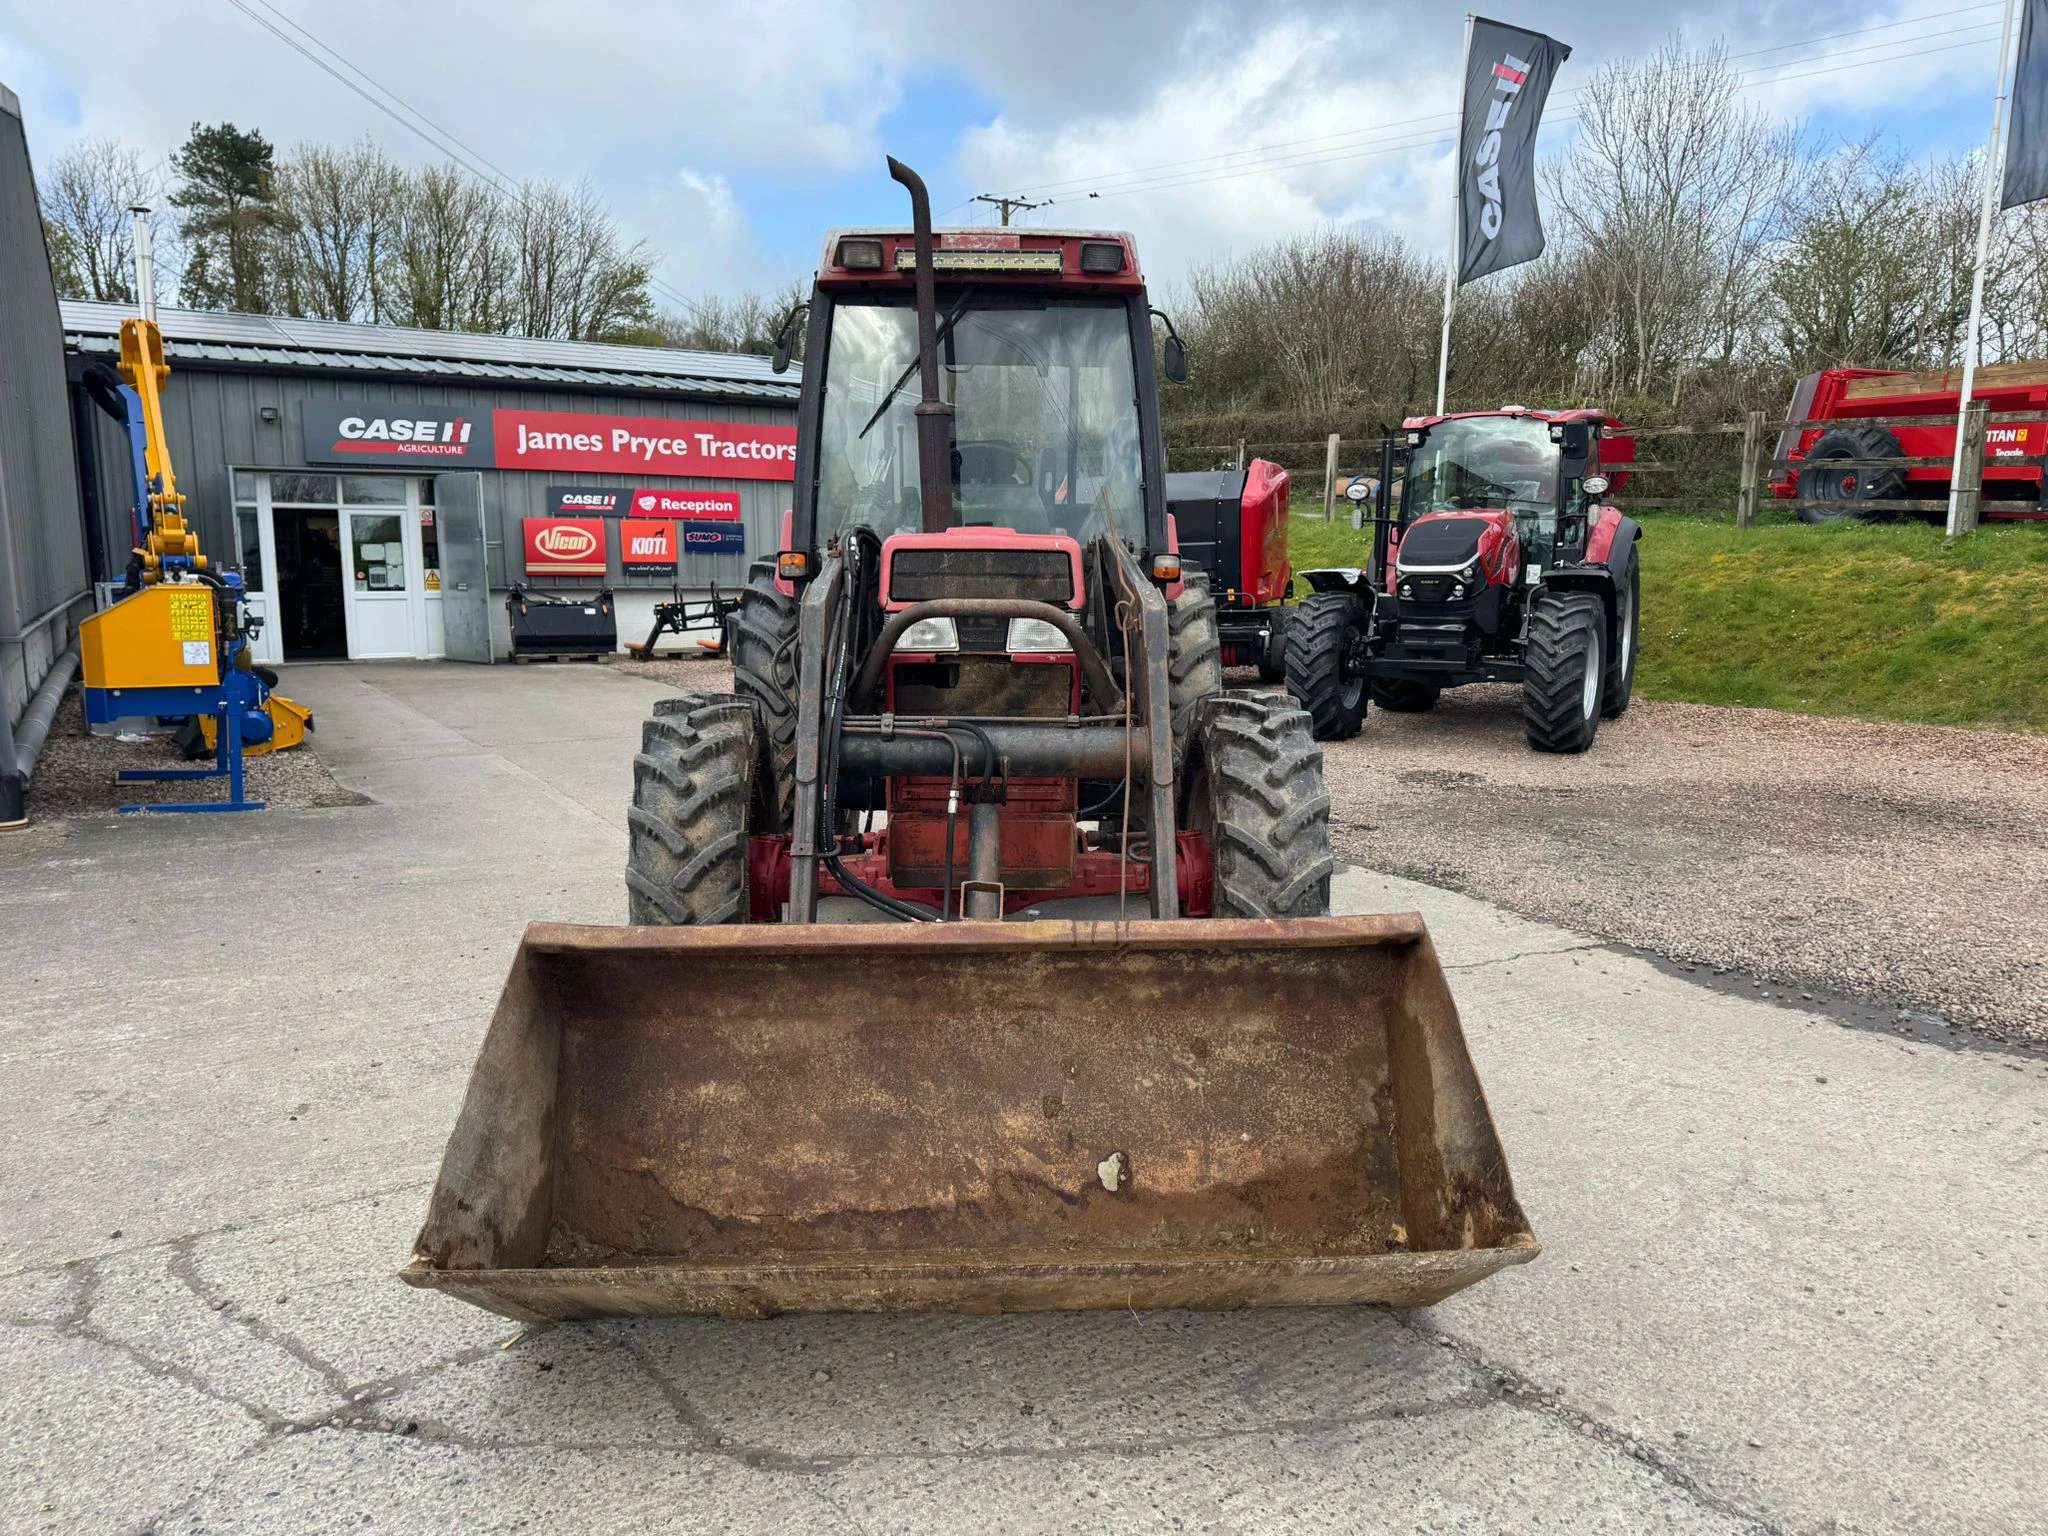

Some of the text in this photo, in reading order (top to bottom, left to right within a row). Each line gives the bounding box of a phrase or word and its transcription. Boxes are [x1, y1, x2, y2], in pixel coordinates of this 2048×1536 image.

[1475, 99, 1513, 240] CASE
[338, 417, 438, 441] CASE
[1986, 429, 2016, 442] ITAN
[397, 444, 463, 454] AGRICULTURE
[516, 424, 797, 461] James Pryce Tractors
[562, 494, 603, 505] CASE
[661, 498, 733, 513] Reception
[544, 528, 589, 550] Vicon
[687, 532, 721, 542] SUMO
[631, 537, 667, 555] KIOTI
